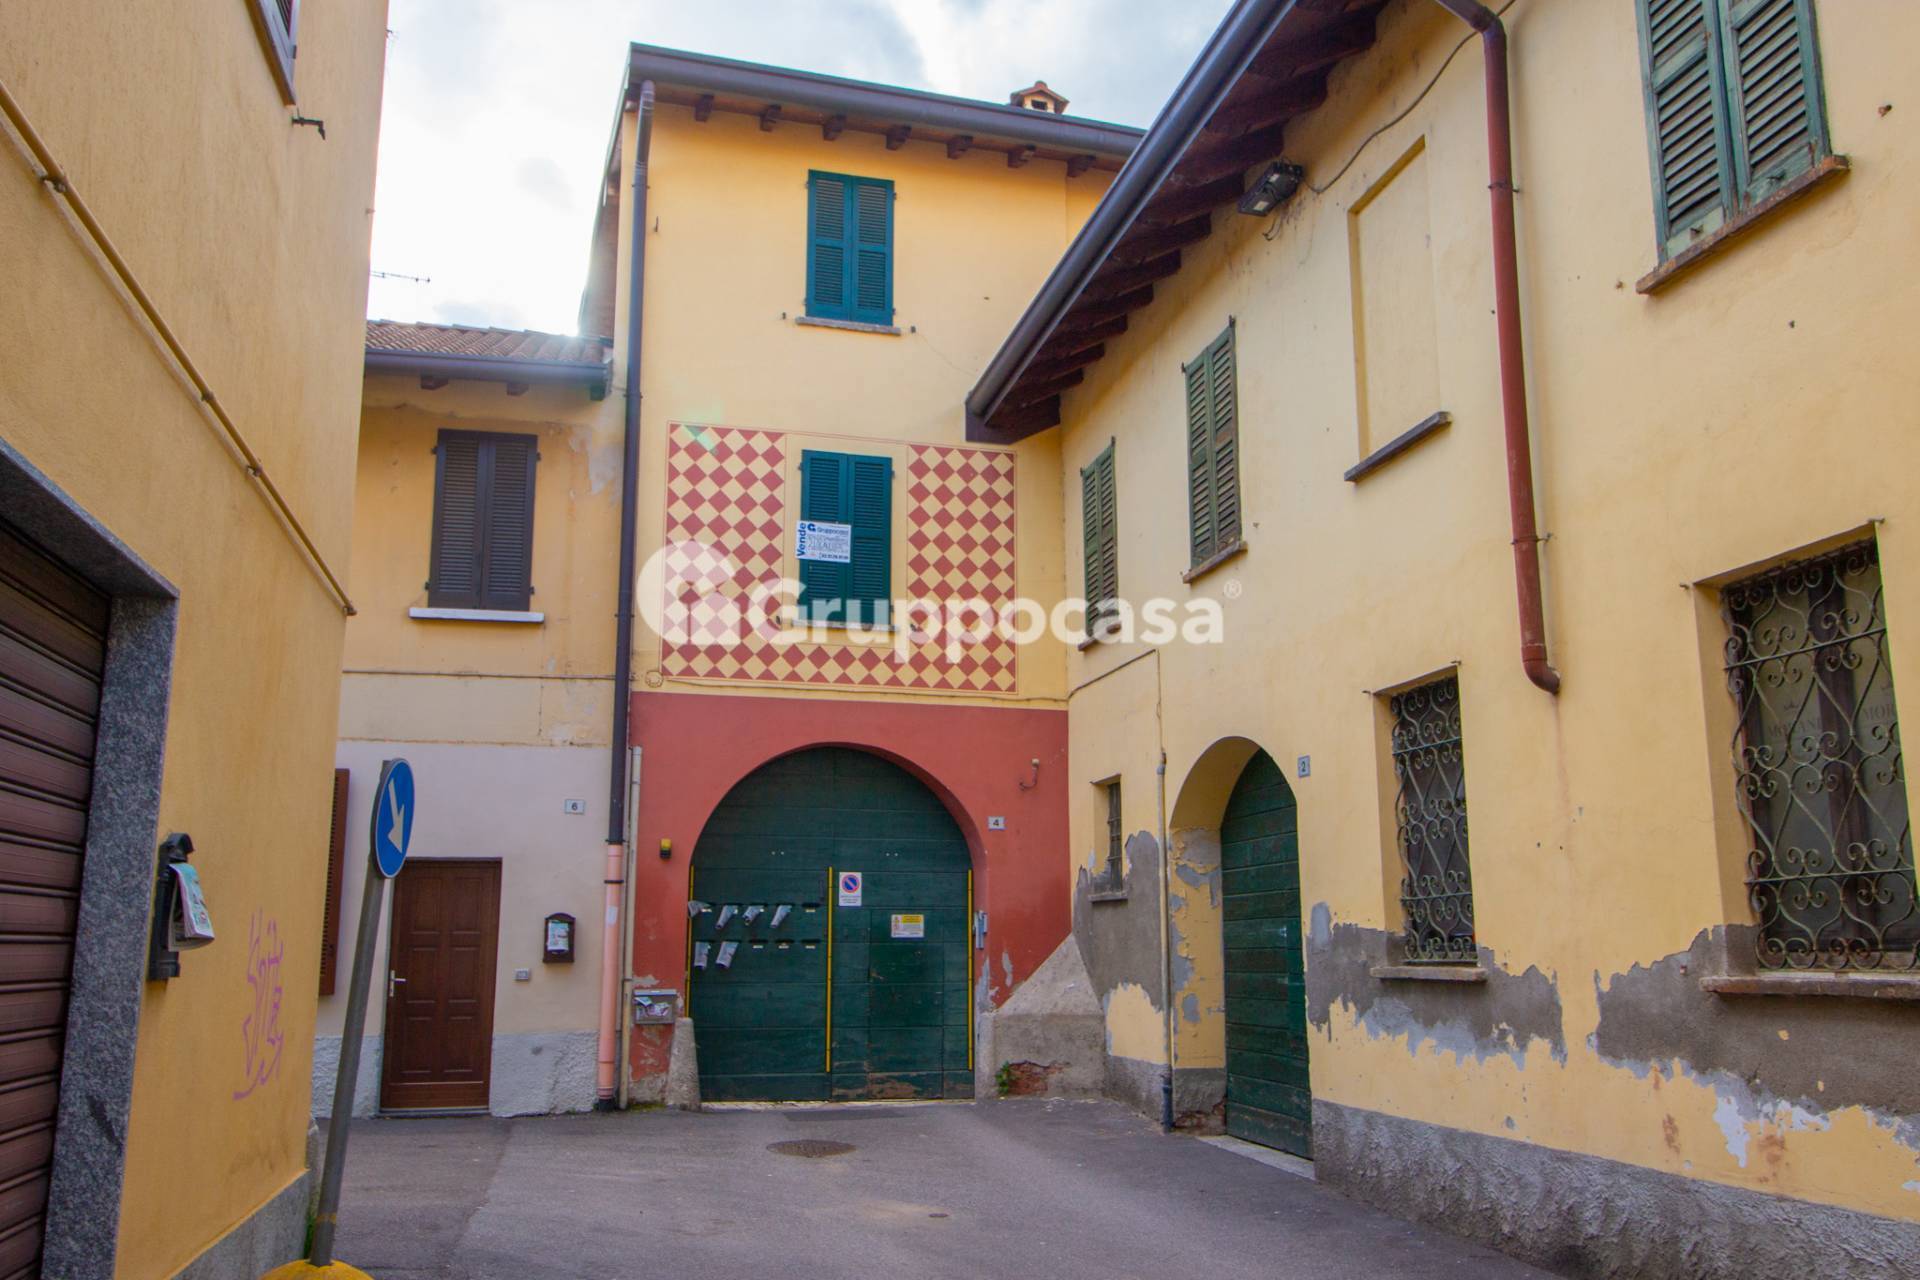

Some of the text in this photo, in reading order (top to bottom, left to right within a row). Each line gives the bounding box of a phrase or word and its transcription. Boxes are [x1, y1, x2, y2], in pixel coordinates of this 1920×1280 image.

[797, 523, 806, 556] Vende
[1300, 760, 1307, 772] 2
[571, 801, 578, 811] 6
[992, 819, 1000, 828] 4
